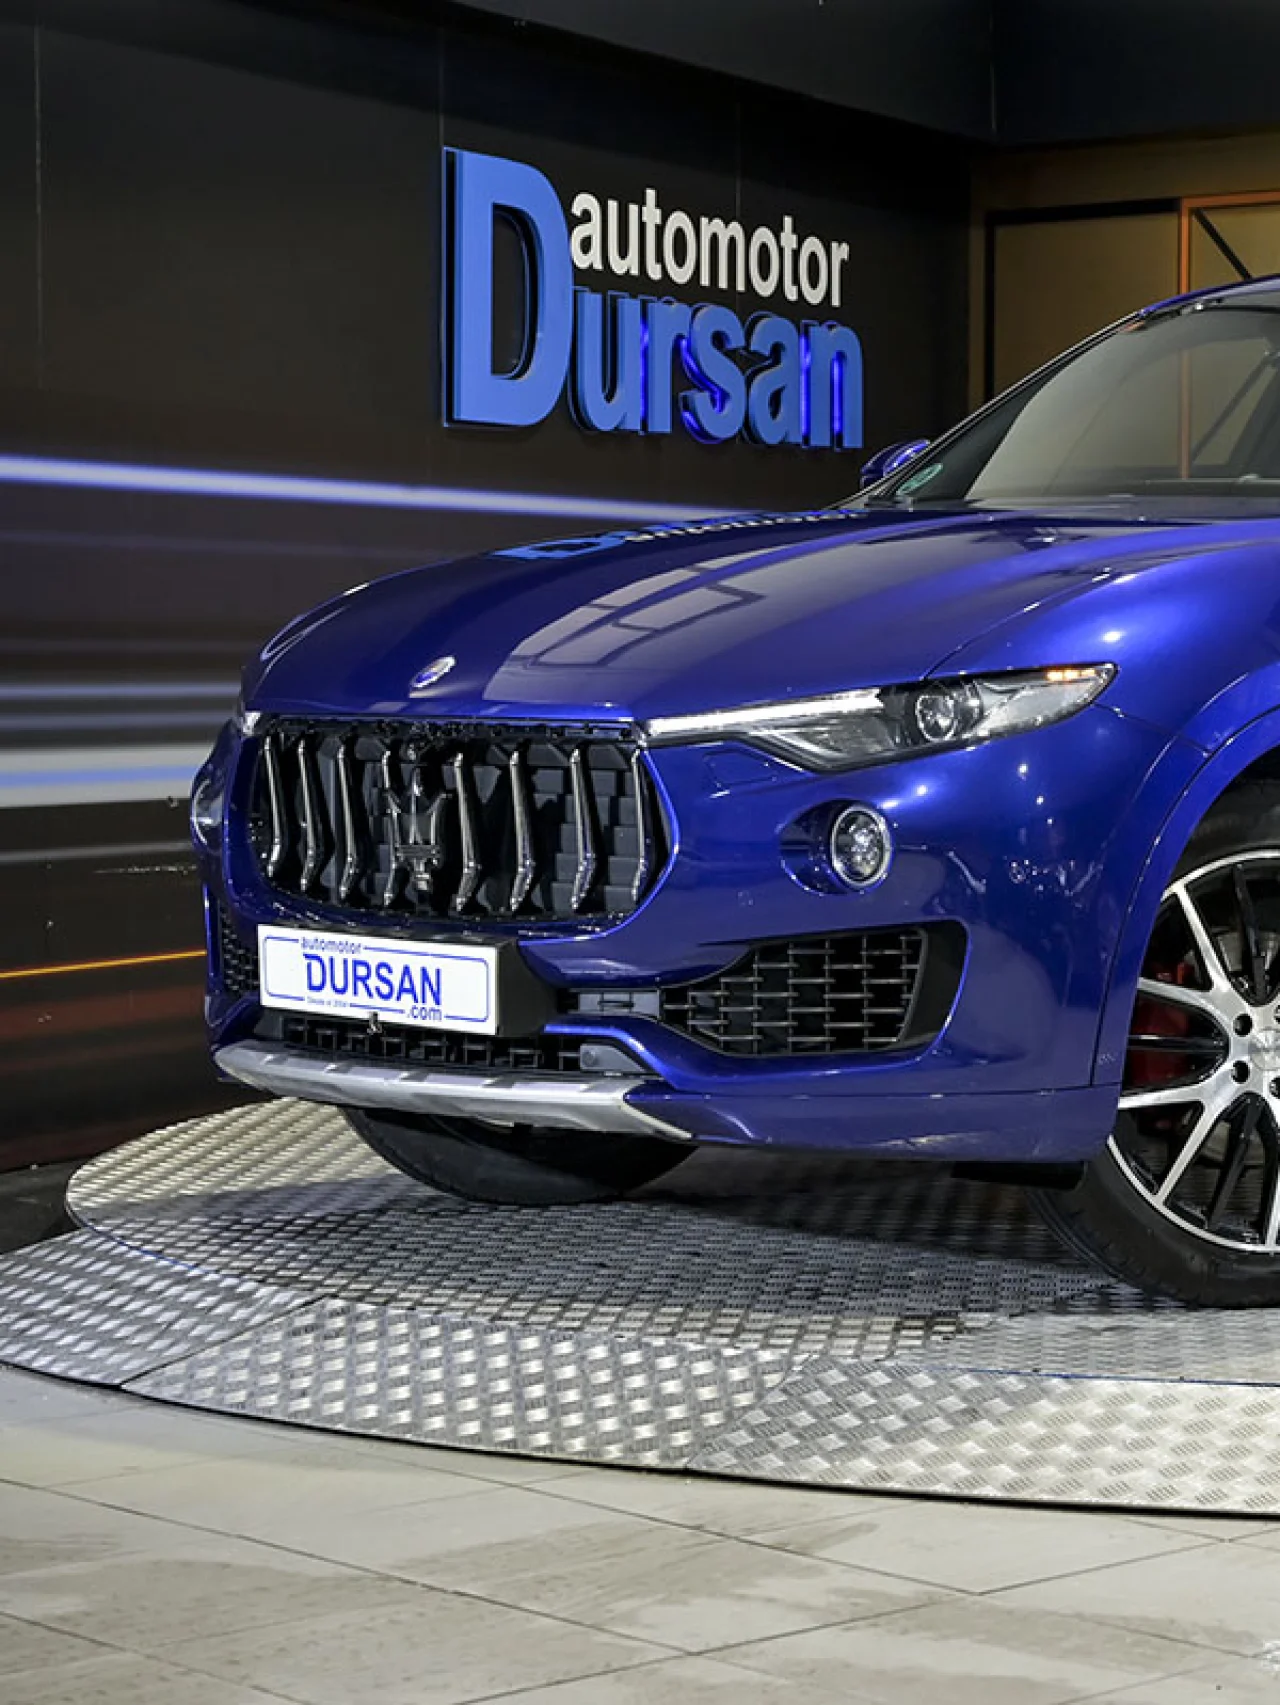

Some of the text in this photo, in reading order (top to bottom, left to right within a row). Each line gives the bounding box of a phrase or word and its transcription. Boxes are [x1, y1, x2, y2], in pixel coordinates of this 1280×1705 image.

[570, 188, 849, 307] automotor
[443, 147, 864, 450] Dursan
[301, 937, 362, 954] automotor
[303, 953, 442, 1006] DURSAN
[406, 1004, 443, 1021] .com
